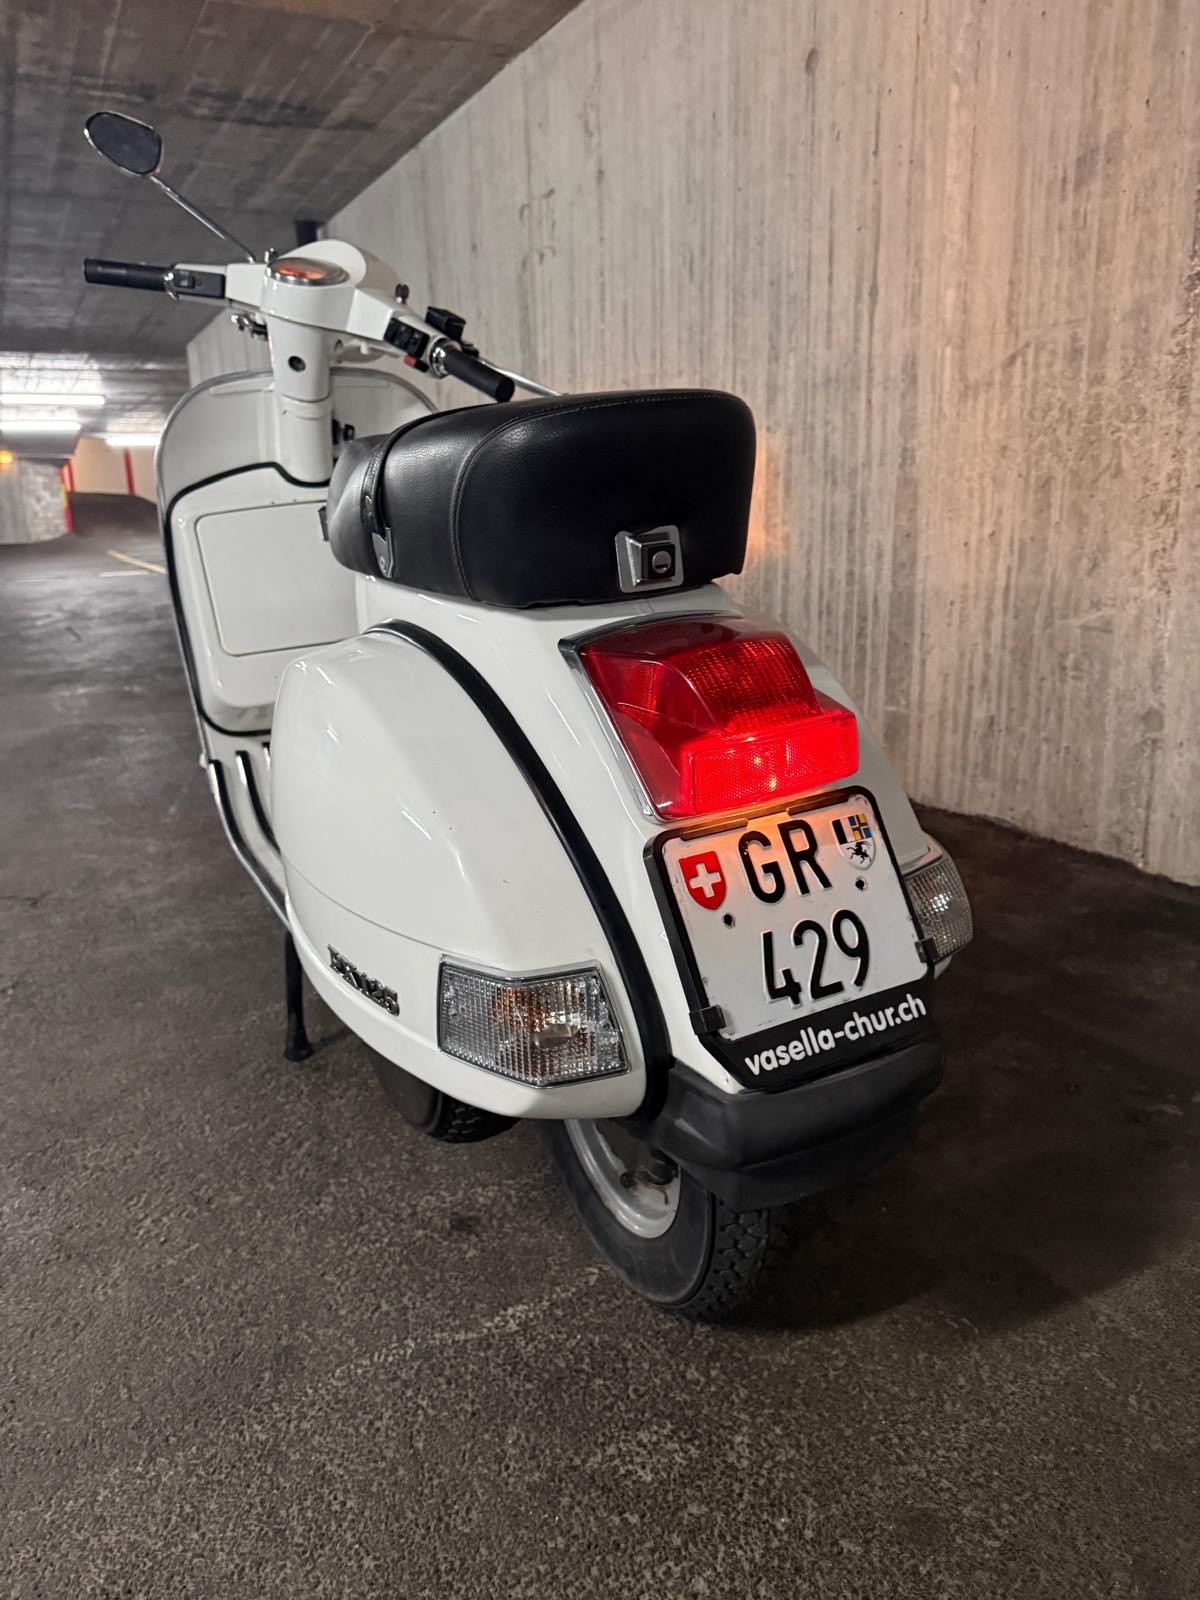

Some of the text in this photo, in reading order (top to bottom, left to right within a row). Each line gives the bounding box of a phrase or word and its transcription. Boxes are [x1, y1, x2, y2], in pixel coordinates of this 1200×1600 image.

[738, 819, 832, 903] GR
[762, 909, 870, 1007] 429
[745, 993, 926, 1076] vasella-chur.ch
